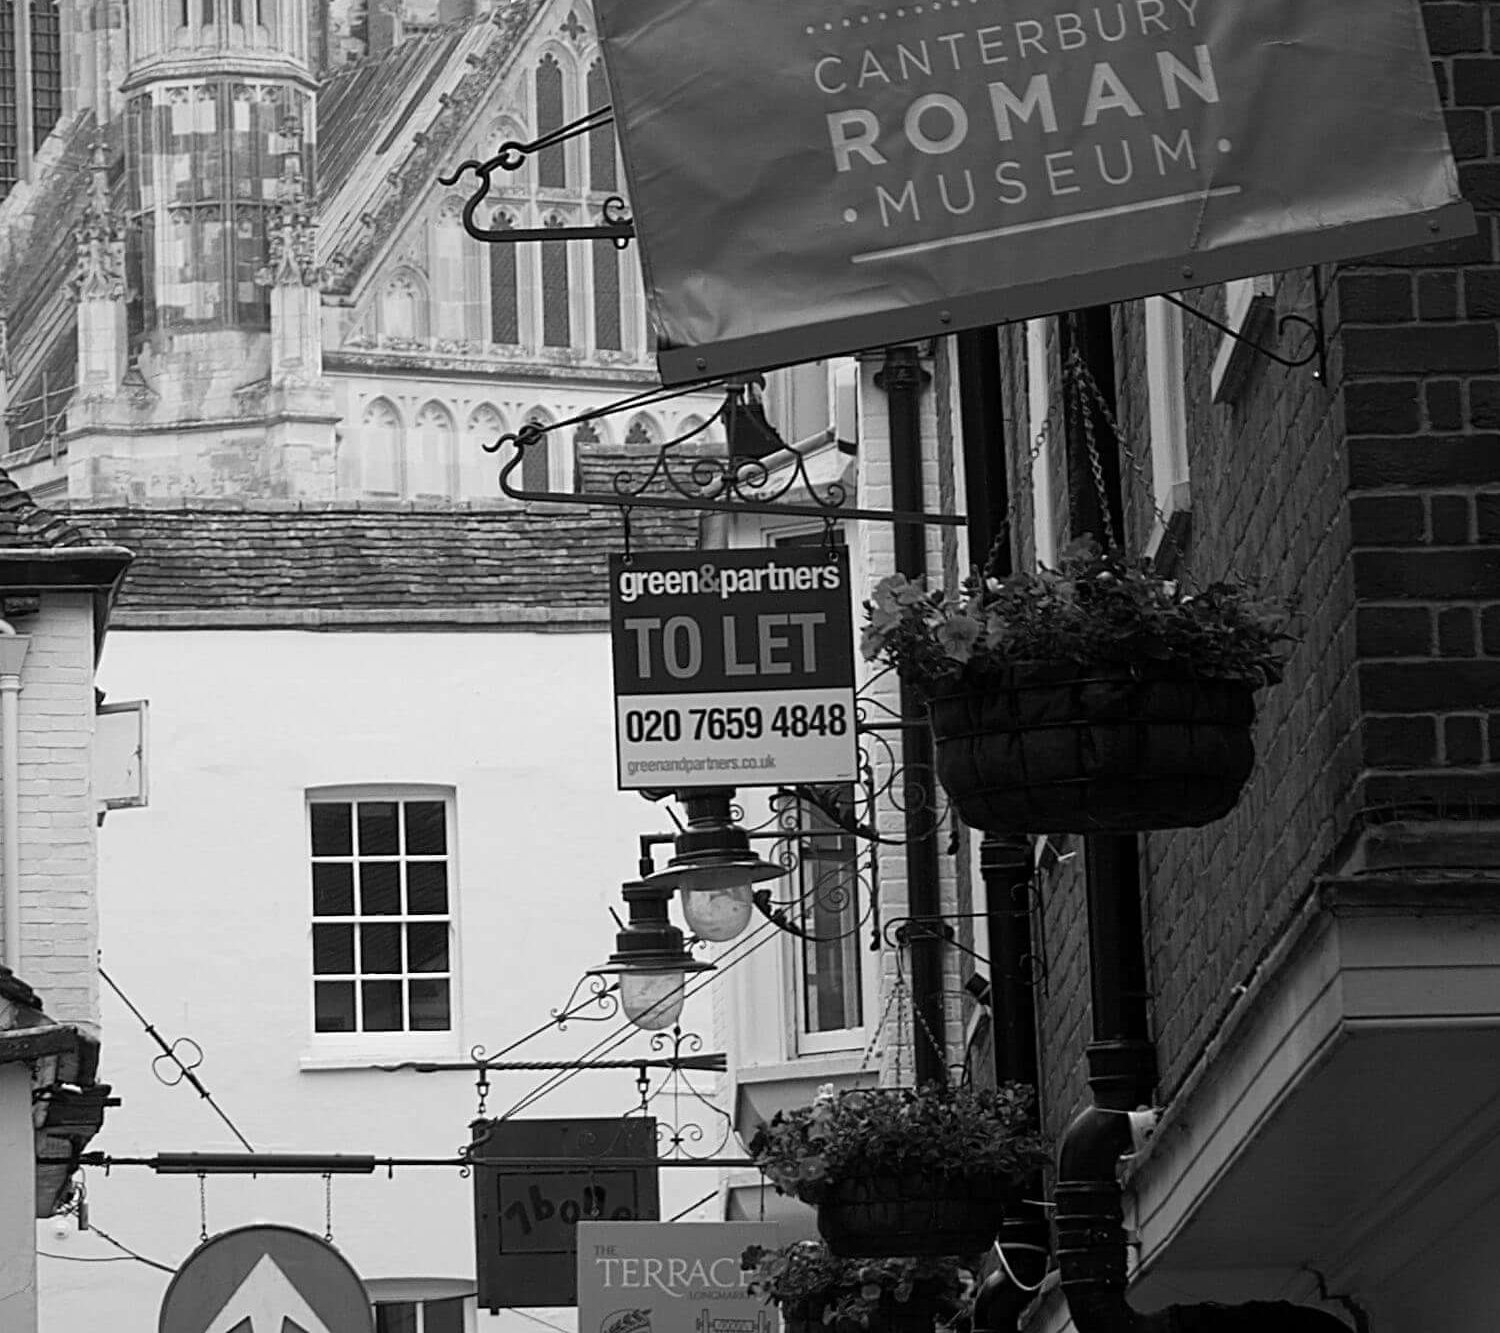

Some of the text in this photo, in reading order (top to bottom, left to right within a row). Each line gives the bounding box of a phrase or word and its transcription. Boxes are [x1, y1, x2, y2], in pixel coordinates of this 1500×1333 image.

[823, 42, 1222, 173] ROMAN
[875, 129, 1198, 228] MUSEUM
[618, 561, 841, 603] green&partners
[623, 612, 828, 679] TO LET
[626, 703, 847, 743] 020 7659 4848
[626, 753, 777, 778] greenandpartners.co.uk
[593, 1245, 617, 1257] THE
